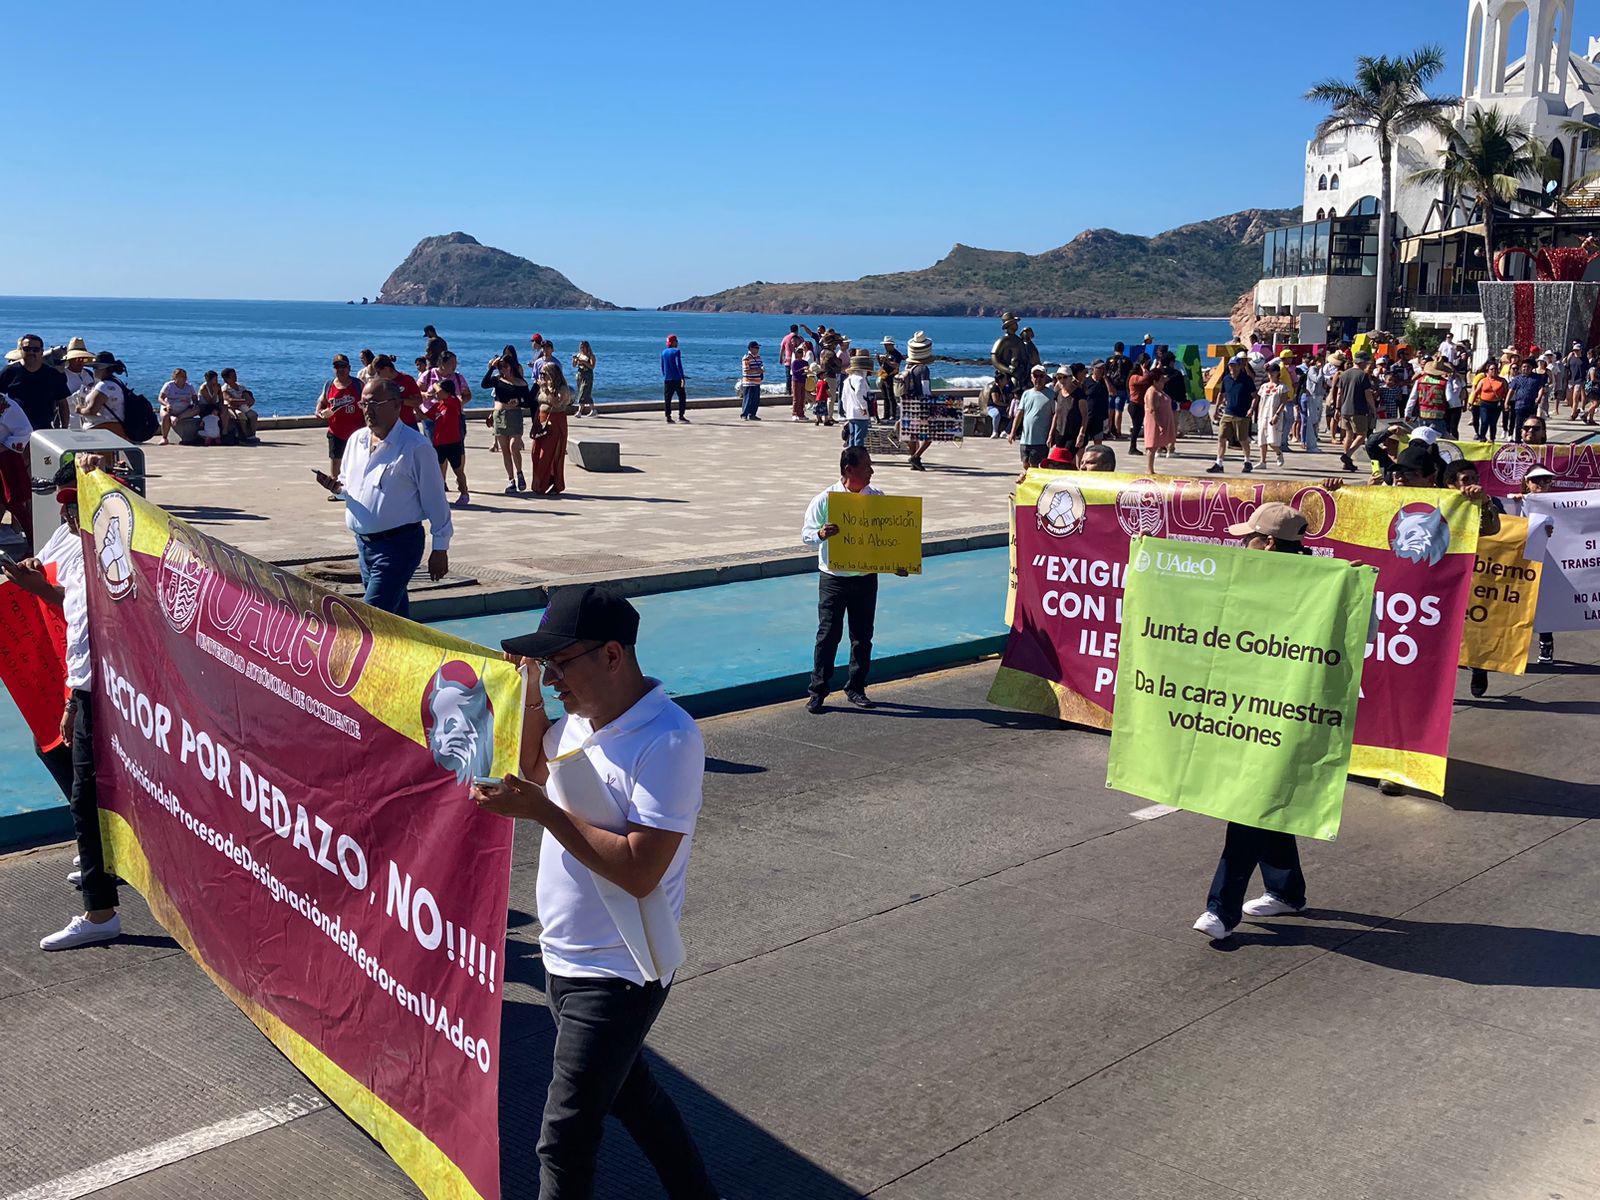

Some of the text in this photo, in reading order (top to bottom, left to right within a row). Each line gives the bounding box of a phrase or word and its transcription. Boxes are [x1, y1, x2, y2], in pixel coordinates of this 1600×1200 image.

[1544, 442, 1600, 478] UA
[843, 510, 857, 526] No
[1172, 480, 1338, 540] UAdO
[843, 532, 857, 545] No
[1585, 539, 1597, 550] SI
[1156, 551, 1217, 576] UAdeO
[1473, 554, 1537, 582] bierno
[1042, 590, 1105, 622] CON
[1474, 584, 1520, 604] en la
[1574, 593, 1588, 604] NO
[1079, 629, 1120, 659] ILE
[1141, 616, 1341, 667] Junta de Gobierno
[292, 687, 306, 711] DE
[305, 695, 361, 741] OCCIDENTE
[1135, 669, 1155, 695] Da
[1159, 675, 1177, 699] la
[1181, 684, 1228, 708] cara
[1231, 692, 1246, 714] y
[1248, 695, 1343, 728] muestra
[1168, 710, 1282, 747] votaciones
[180, 717, 234, 798] POR
